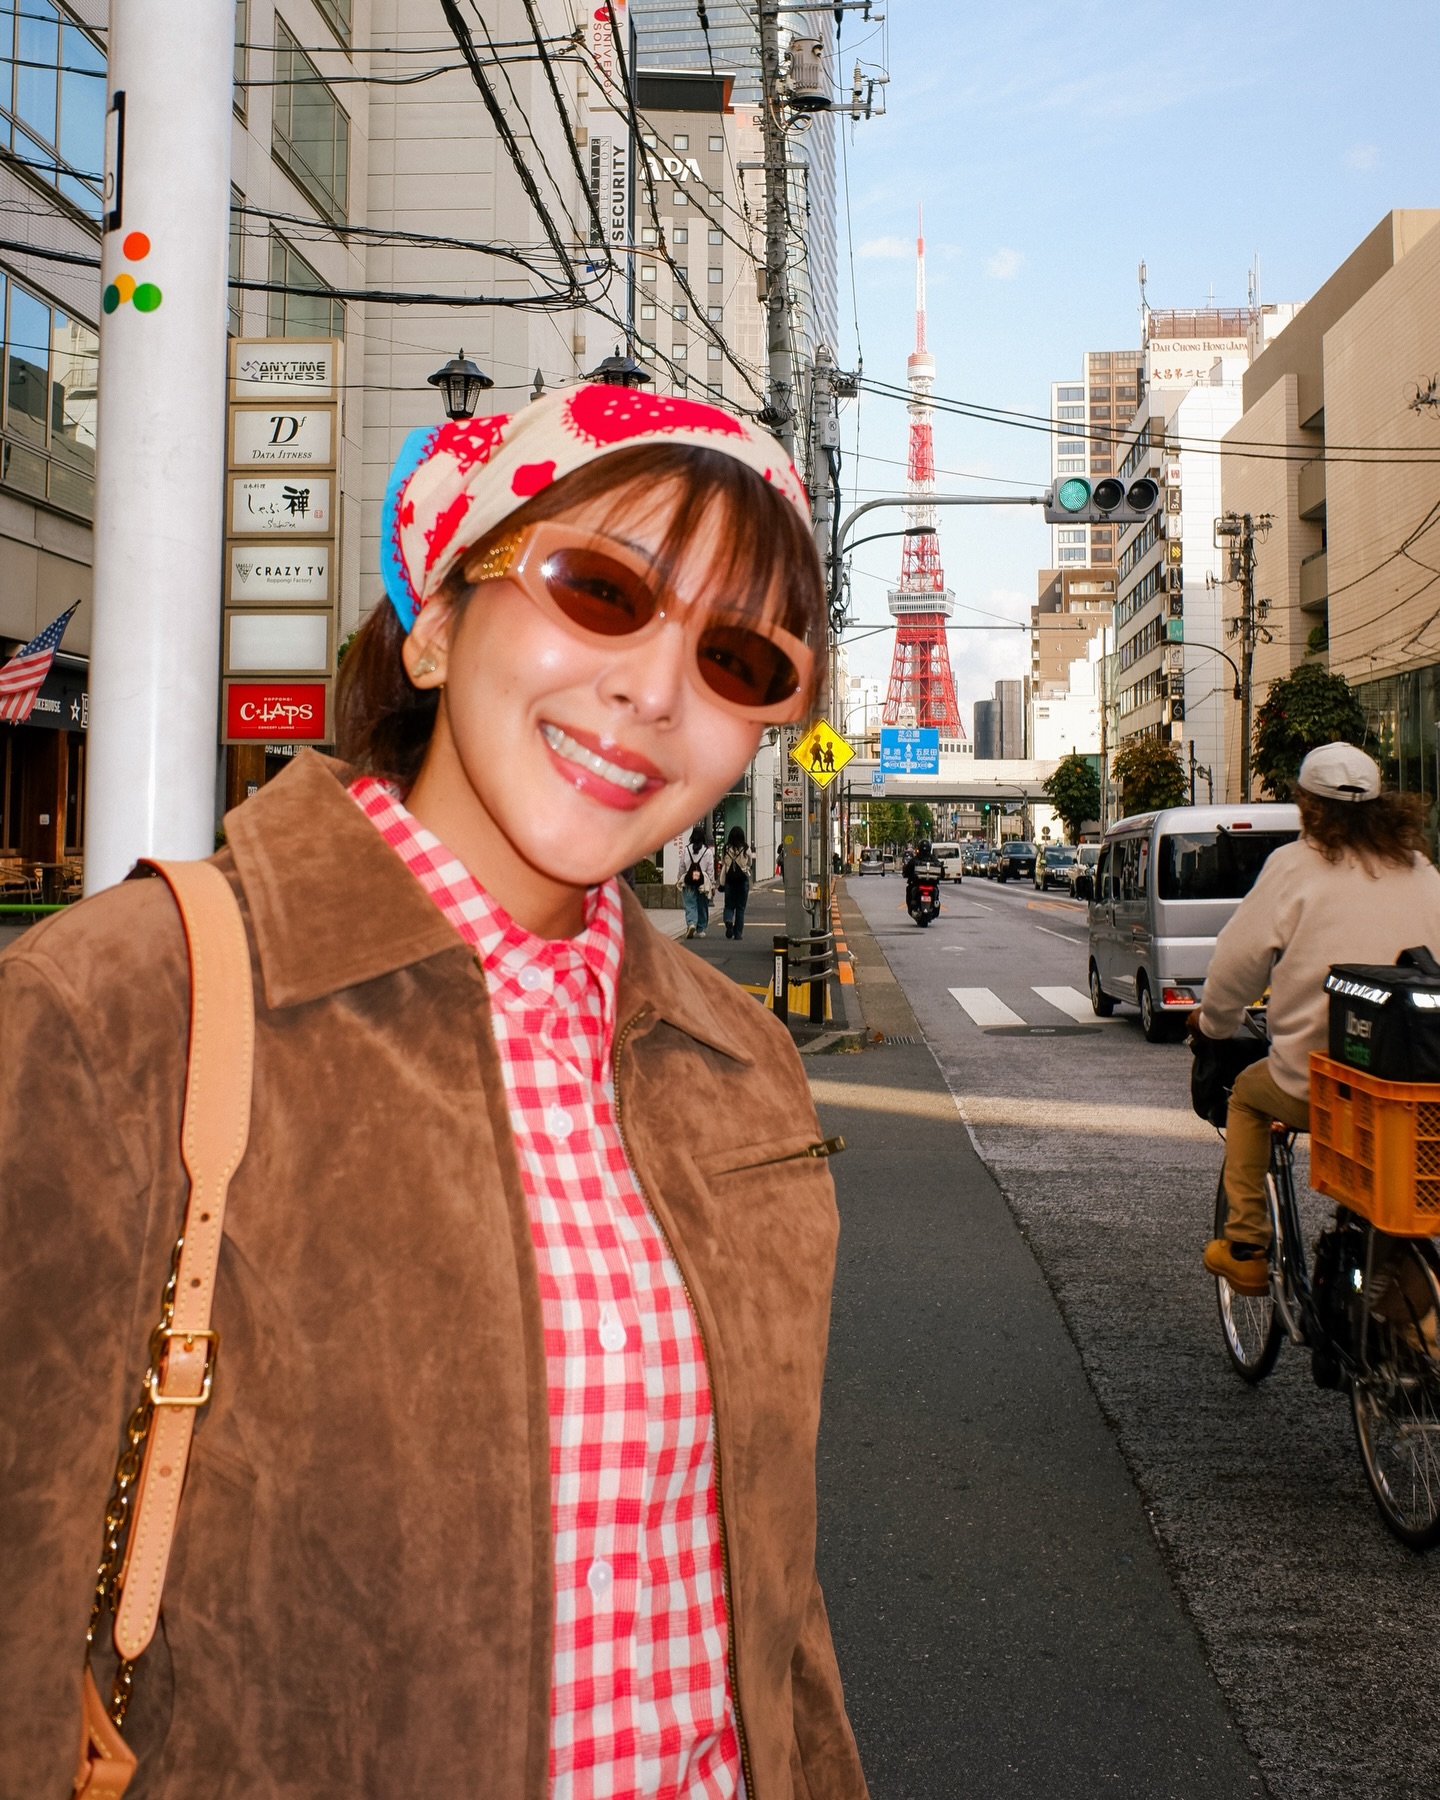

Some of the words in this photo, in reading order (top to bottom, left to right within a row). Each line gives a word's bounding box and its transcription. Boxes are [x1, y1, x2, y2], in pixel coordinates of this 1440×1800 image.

[593, 23, 602, 70] SOLAR
[638, 156, 703, 183] APA
[612, 145, 625, 241] SECURITY
[1152, 342, 1170, 352] DAH
[1172, 342, 1201, 352] CHONG
[1203, 341, 1226, 351] HONG
[259, 361, 326, 371] ANYTIME
[260, 372, 326, 380] FITNESS
[1152, 368, 1211, 380] 大昌第二ビ
[255, 566, 301, 576] CRAZY
[307, 566, 324, 576] TV
